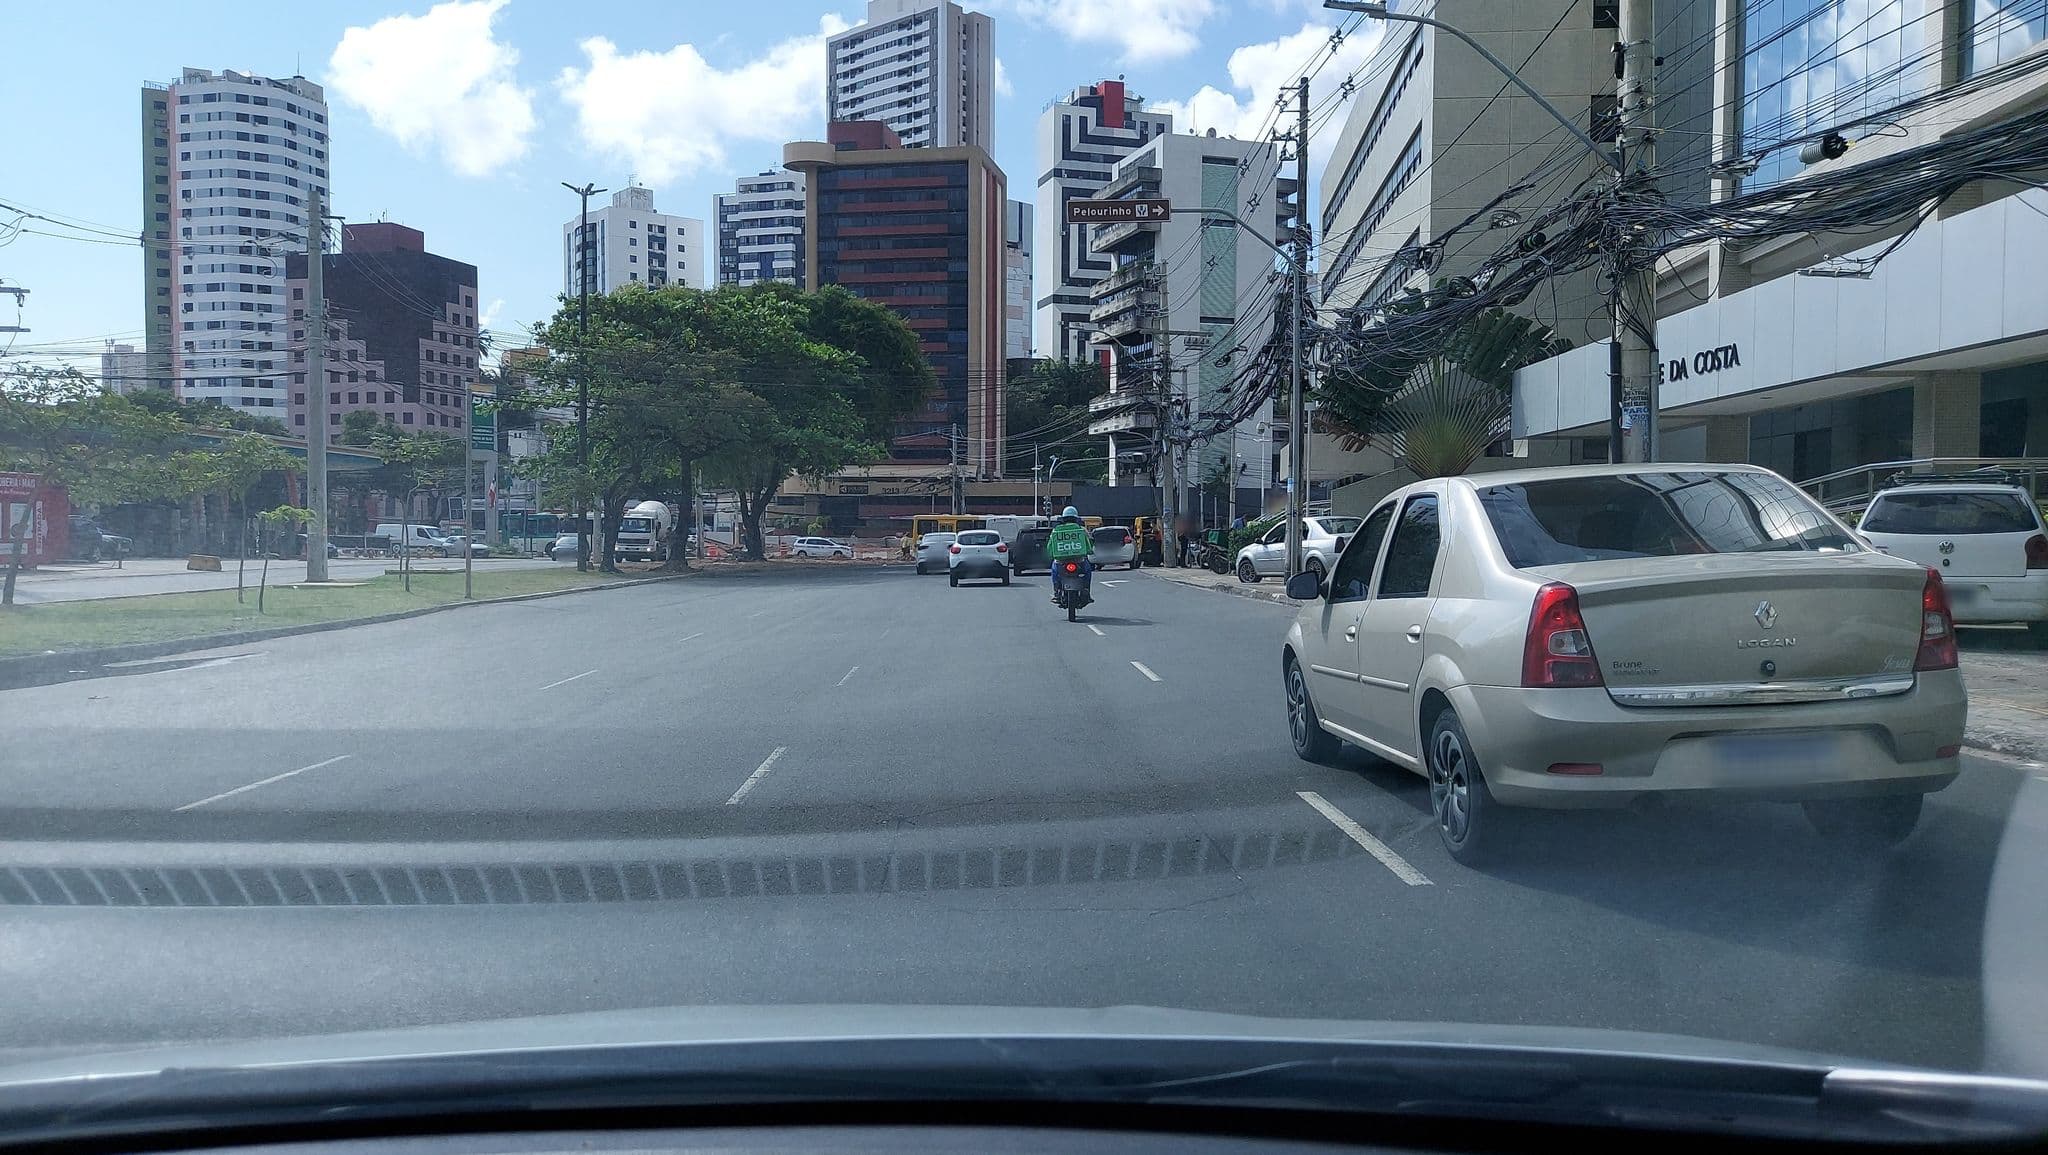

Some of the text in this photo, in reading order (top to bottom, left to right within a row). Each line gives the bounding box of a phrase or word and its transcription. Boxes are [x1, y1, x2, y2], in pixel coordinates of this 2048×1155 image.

[1073, 206, 1132, 216] Pelourinho
[1669, 357, 1689, 382] DA
[1694, 343, 1741, 375] COSTA
[1056, 531, 1081, 541] Uber
[1057, 541, 1082, 551] Eats
[1737, 637, 1796, 650] LOGAN
